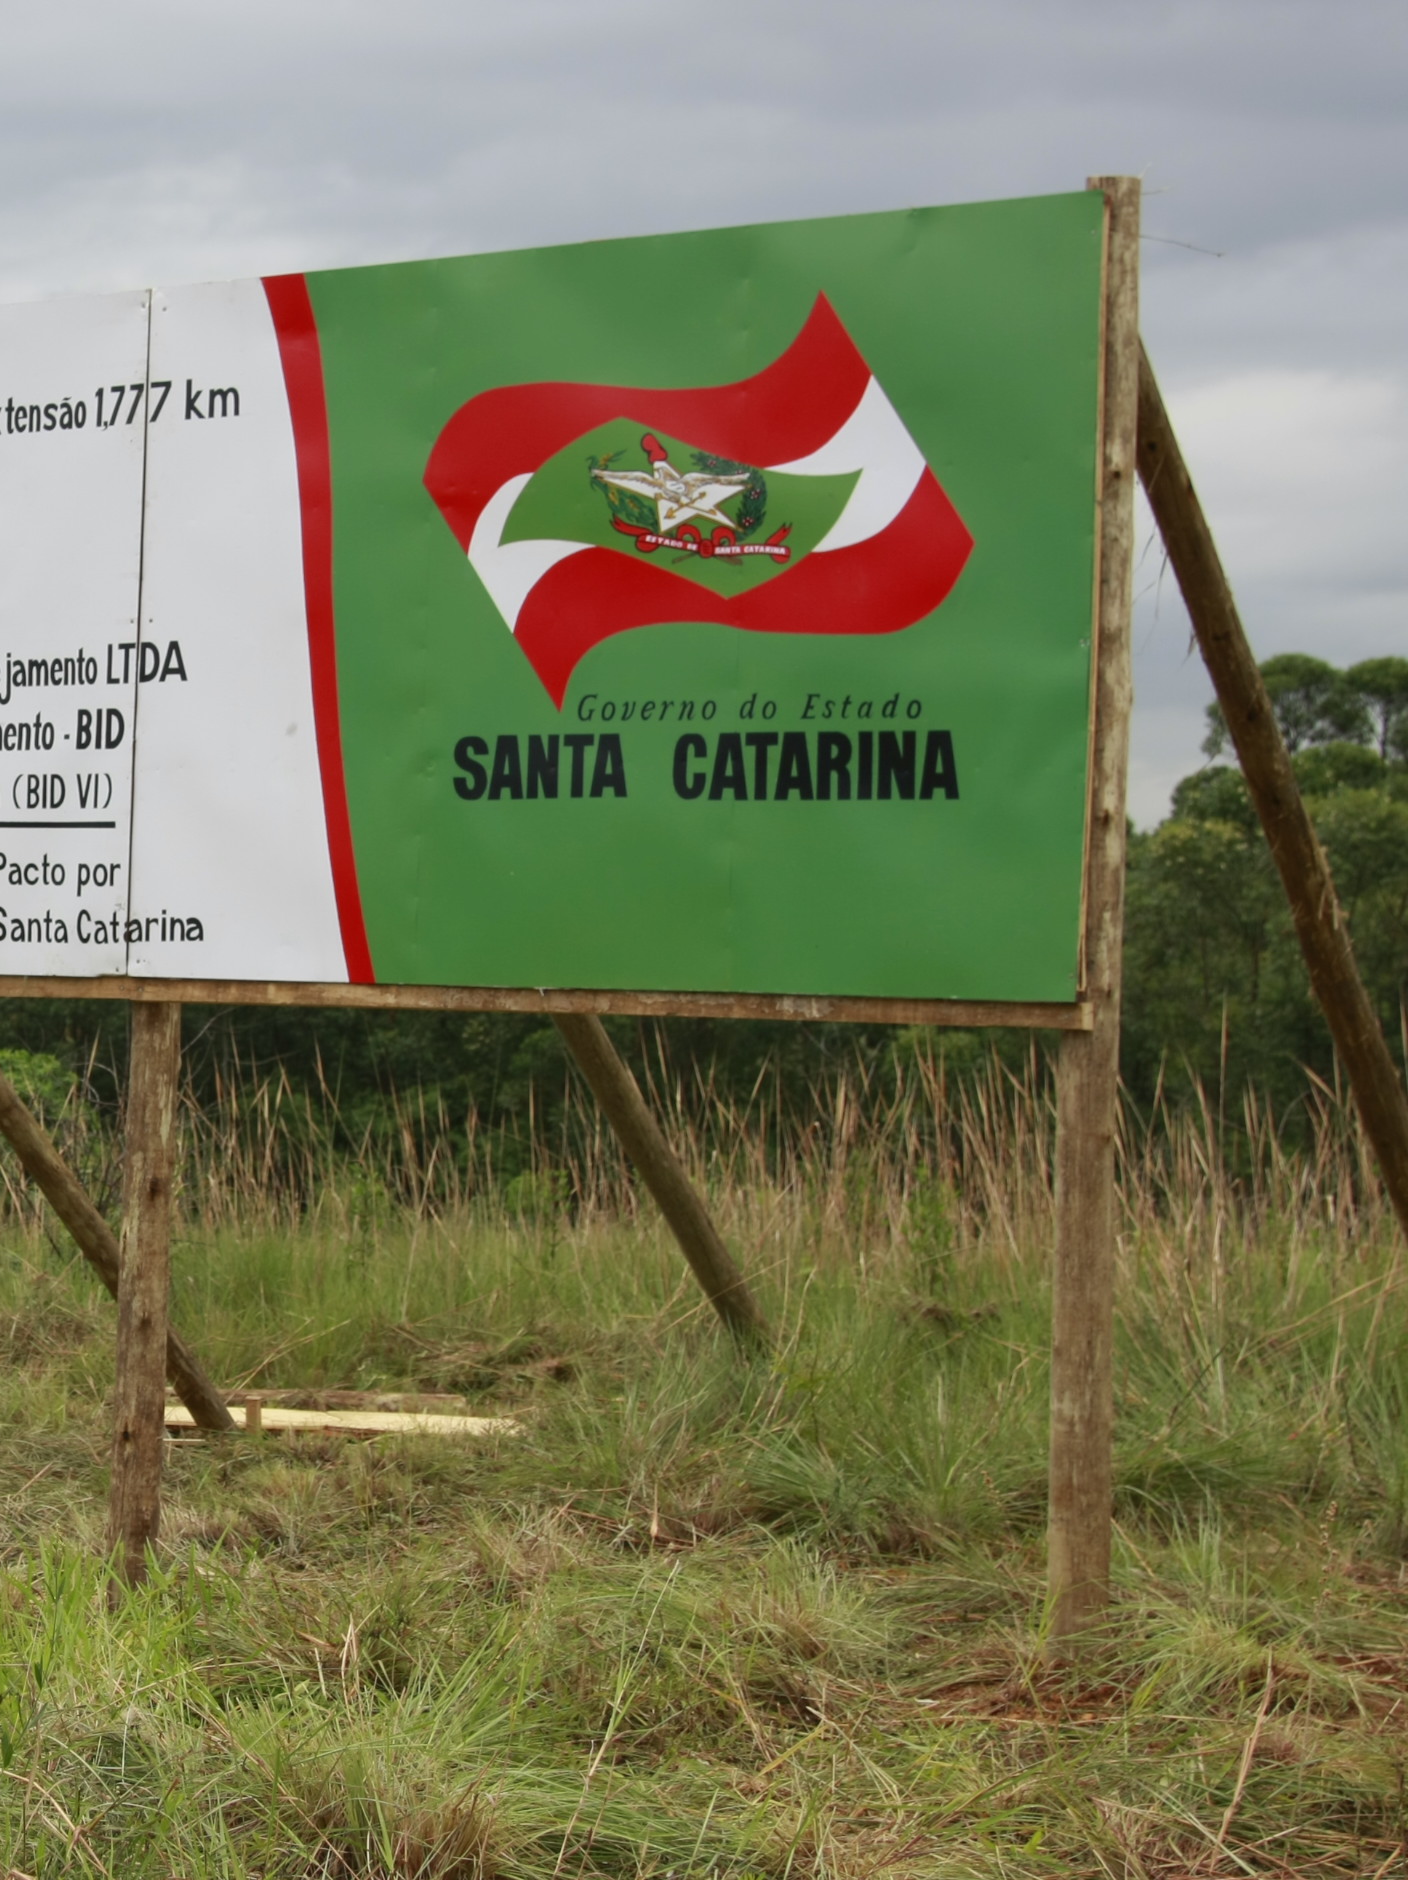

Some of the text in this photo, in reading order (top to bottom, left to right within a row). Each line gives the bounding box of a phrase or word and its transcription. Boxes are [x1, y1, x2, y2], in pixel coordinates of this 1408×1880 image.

[184, 379, 241, 420] km
[106, 640, 188, 684] LTDA
[577, 693, 923, 722] Governo do Estado
[76, 708, 125, 750] BID
[452, 730, 960, 800] SANTA CATARINA
[77, 862, 121, 897] por
[76, 909, 204, 944] Catarina
